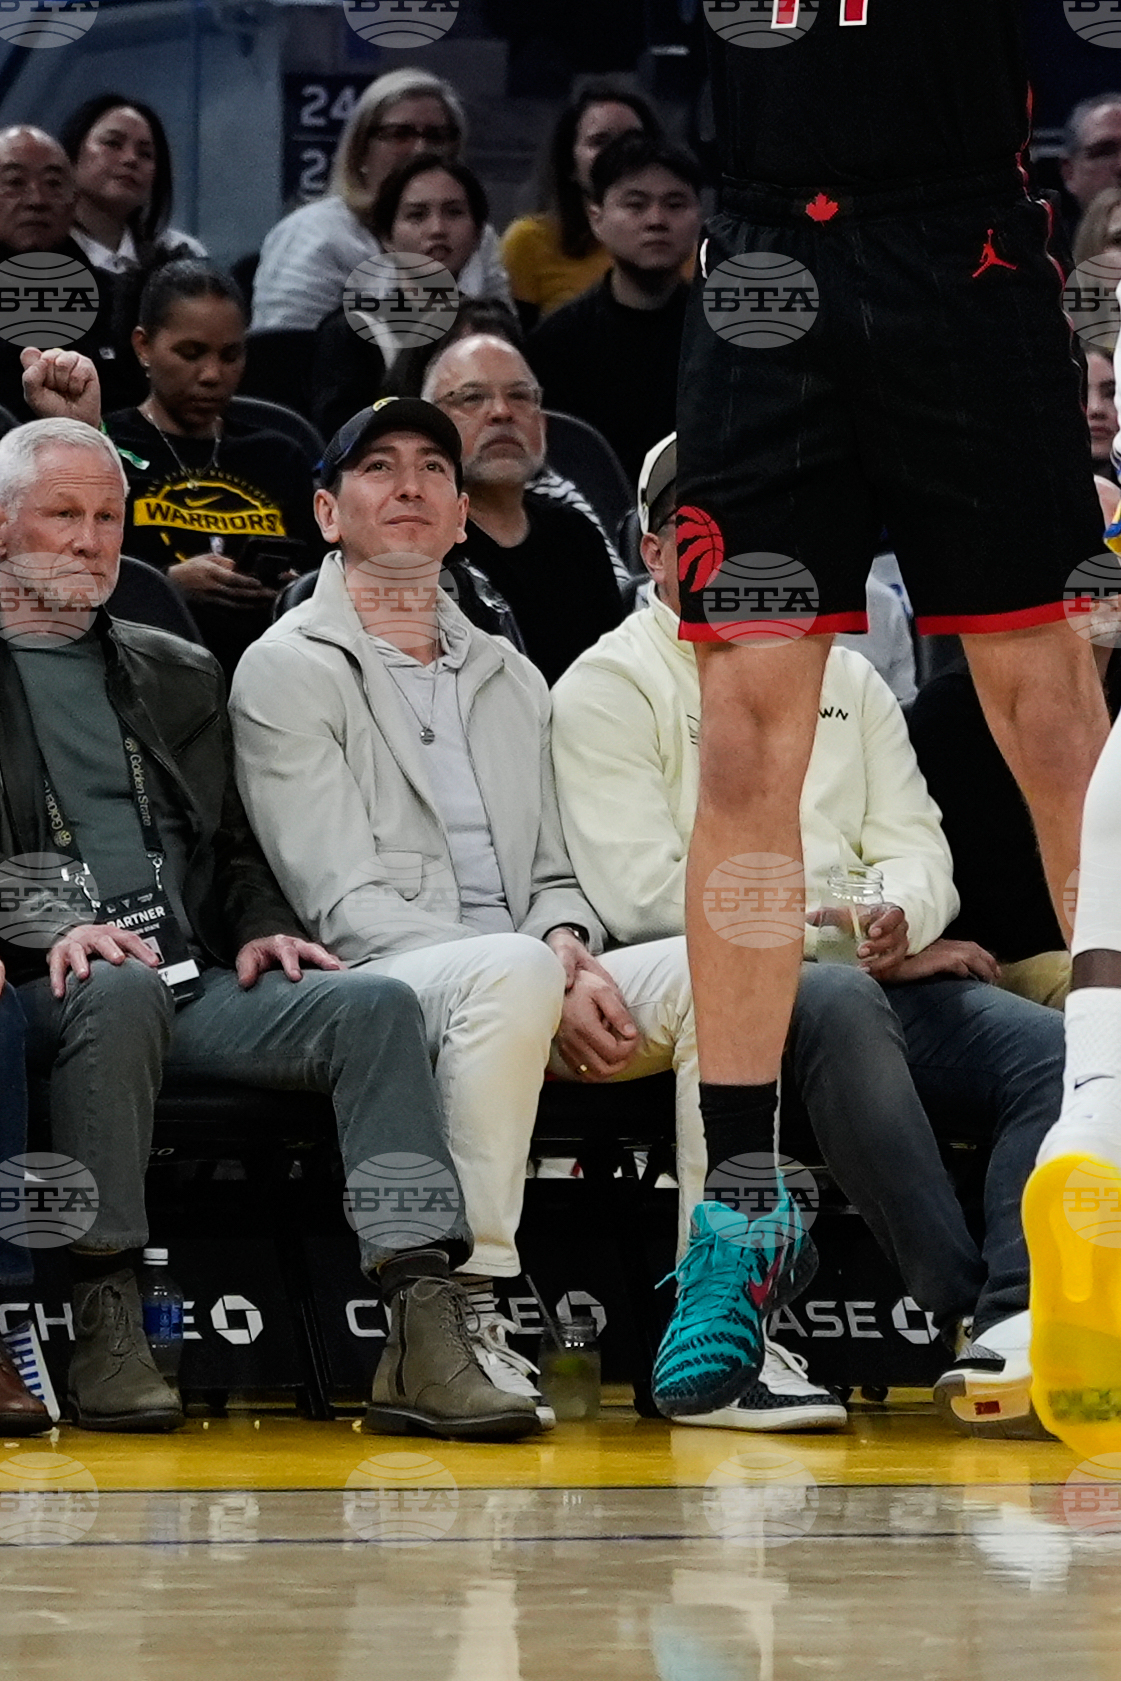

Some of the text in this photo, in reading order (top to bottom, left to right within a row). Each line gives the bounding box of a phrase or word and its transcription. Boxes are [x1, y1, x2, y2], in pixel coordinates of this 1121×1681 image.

[300, 148, 328, 191] 2
[145, 502, 279, 532] WARRIORS
[818, 706, 849, 721] WN
[0, 1300, 203, 1341] CHE
[768, 1301, 884, 1338] ASE
